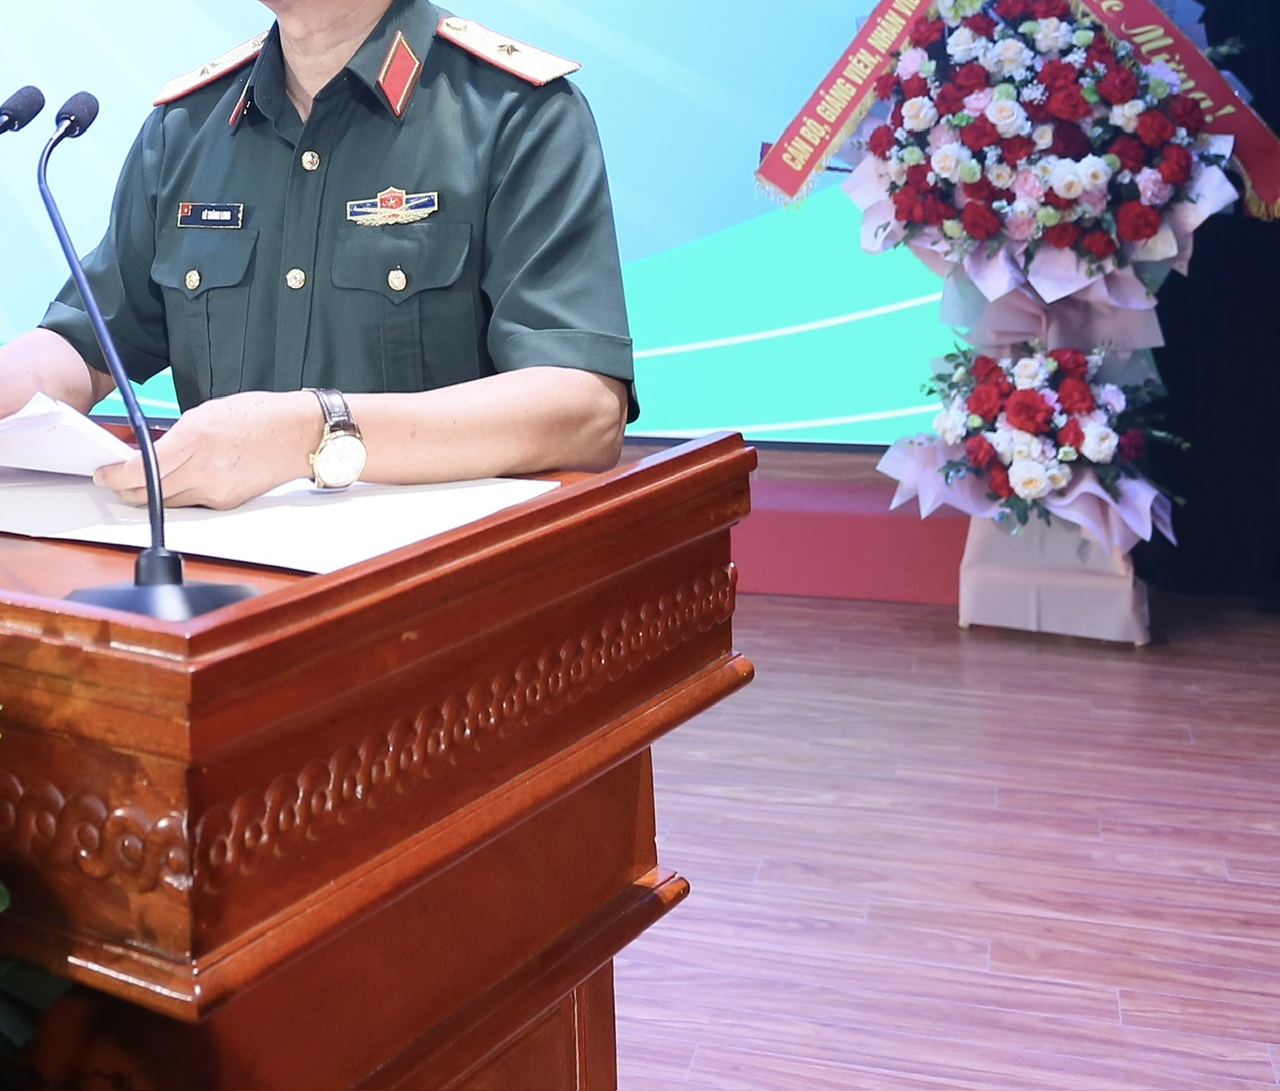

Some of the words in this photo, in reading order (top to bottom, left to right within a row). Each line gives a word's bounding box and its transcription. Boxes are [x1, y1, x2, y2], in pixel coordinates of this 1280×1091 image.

[866, 8, 908, 55] NHÂN
[841, 47, 884, 86] VIÊN,
[815, 76, 858, 124] GIẢNG
[799, 115, 832, 147] BỘ,
[782, 136, 815, 172] CÁN
